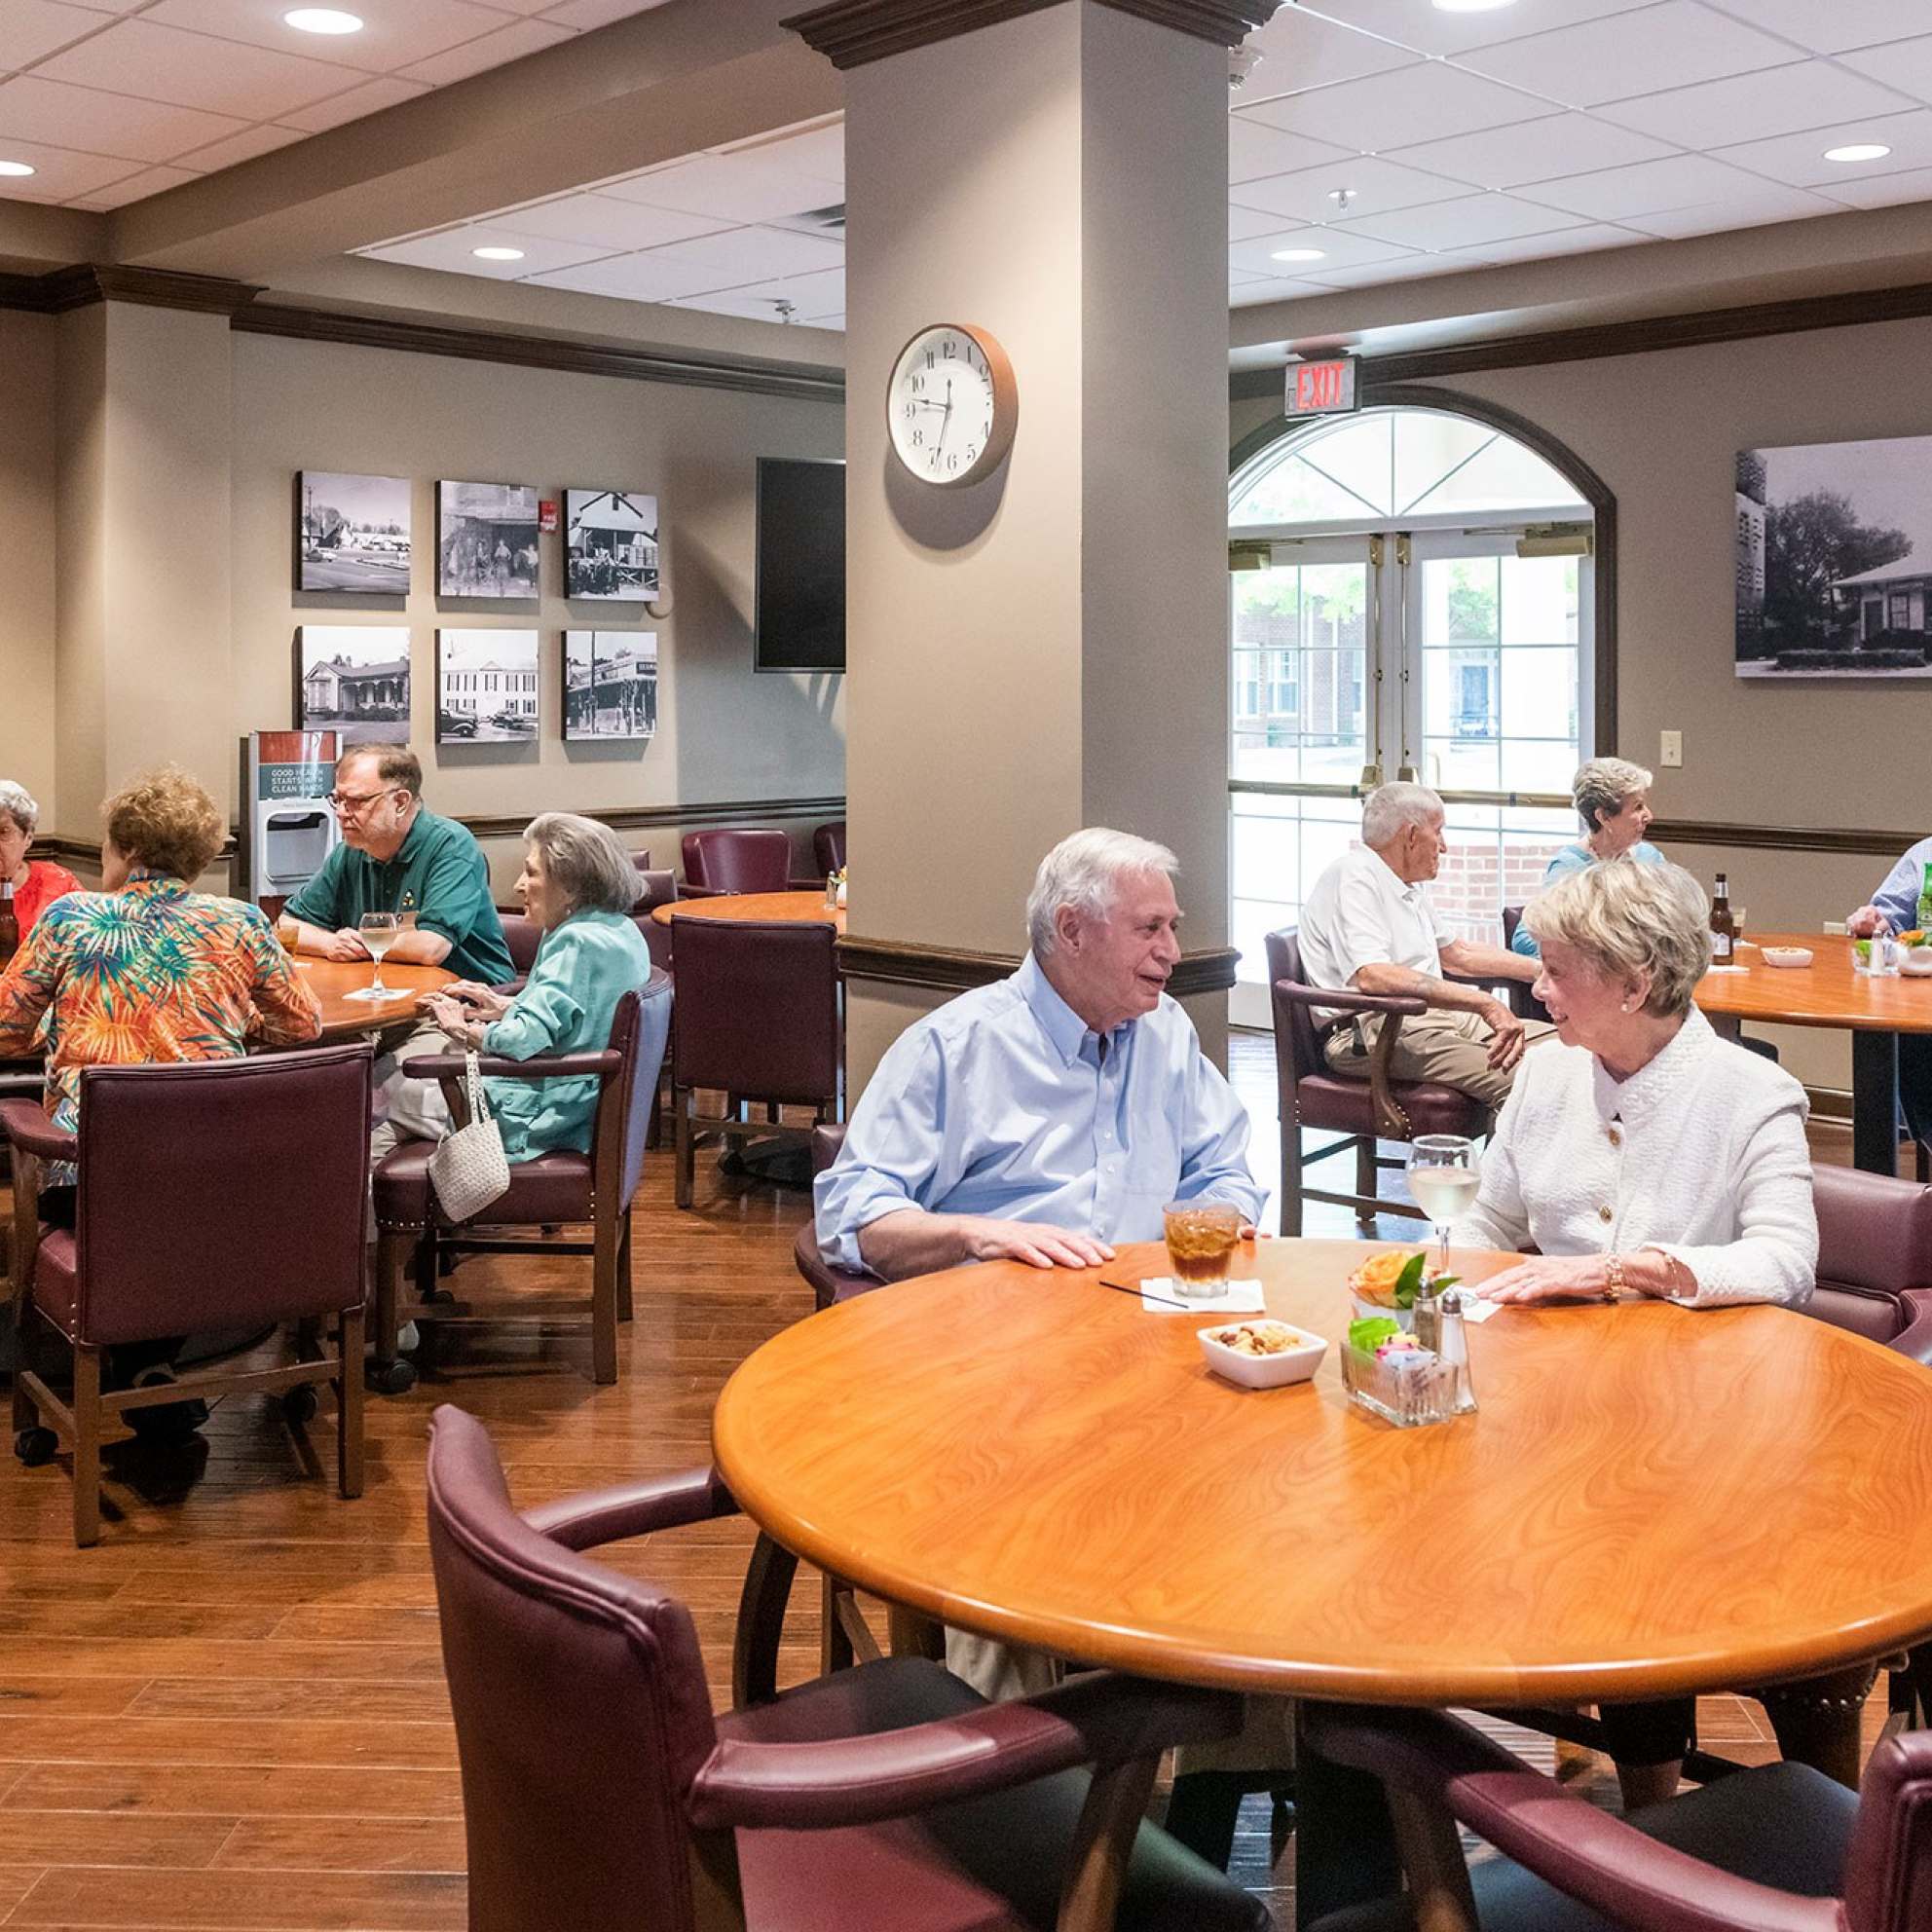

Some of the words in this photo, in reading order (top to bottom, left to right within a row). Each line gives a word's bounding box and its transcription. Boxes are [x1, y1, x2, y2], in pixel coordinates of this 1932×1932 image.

[943, 342, 956, 359] 12
[926, 351, 935, 370] 11
[911, 373, 925, 393] 10
[1297, 361, 1344, 409] EXIT
[905, 403, 916, 419] 9
[912, 429, 923, 447] 8
[928, 446, 936, 465] 7
[966, 443, 976, 461] 5
[947, 453, 957, 470] 6
[272, 768, 294, 777] GOOD
